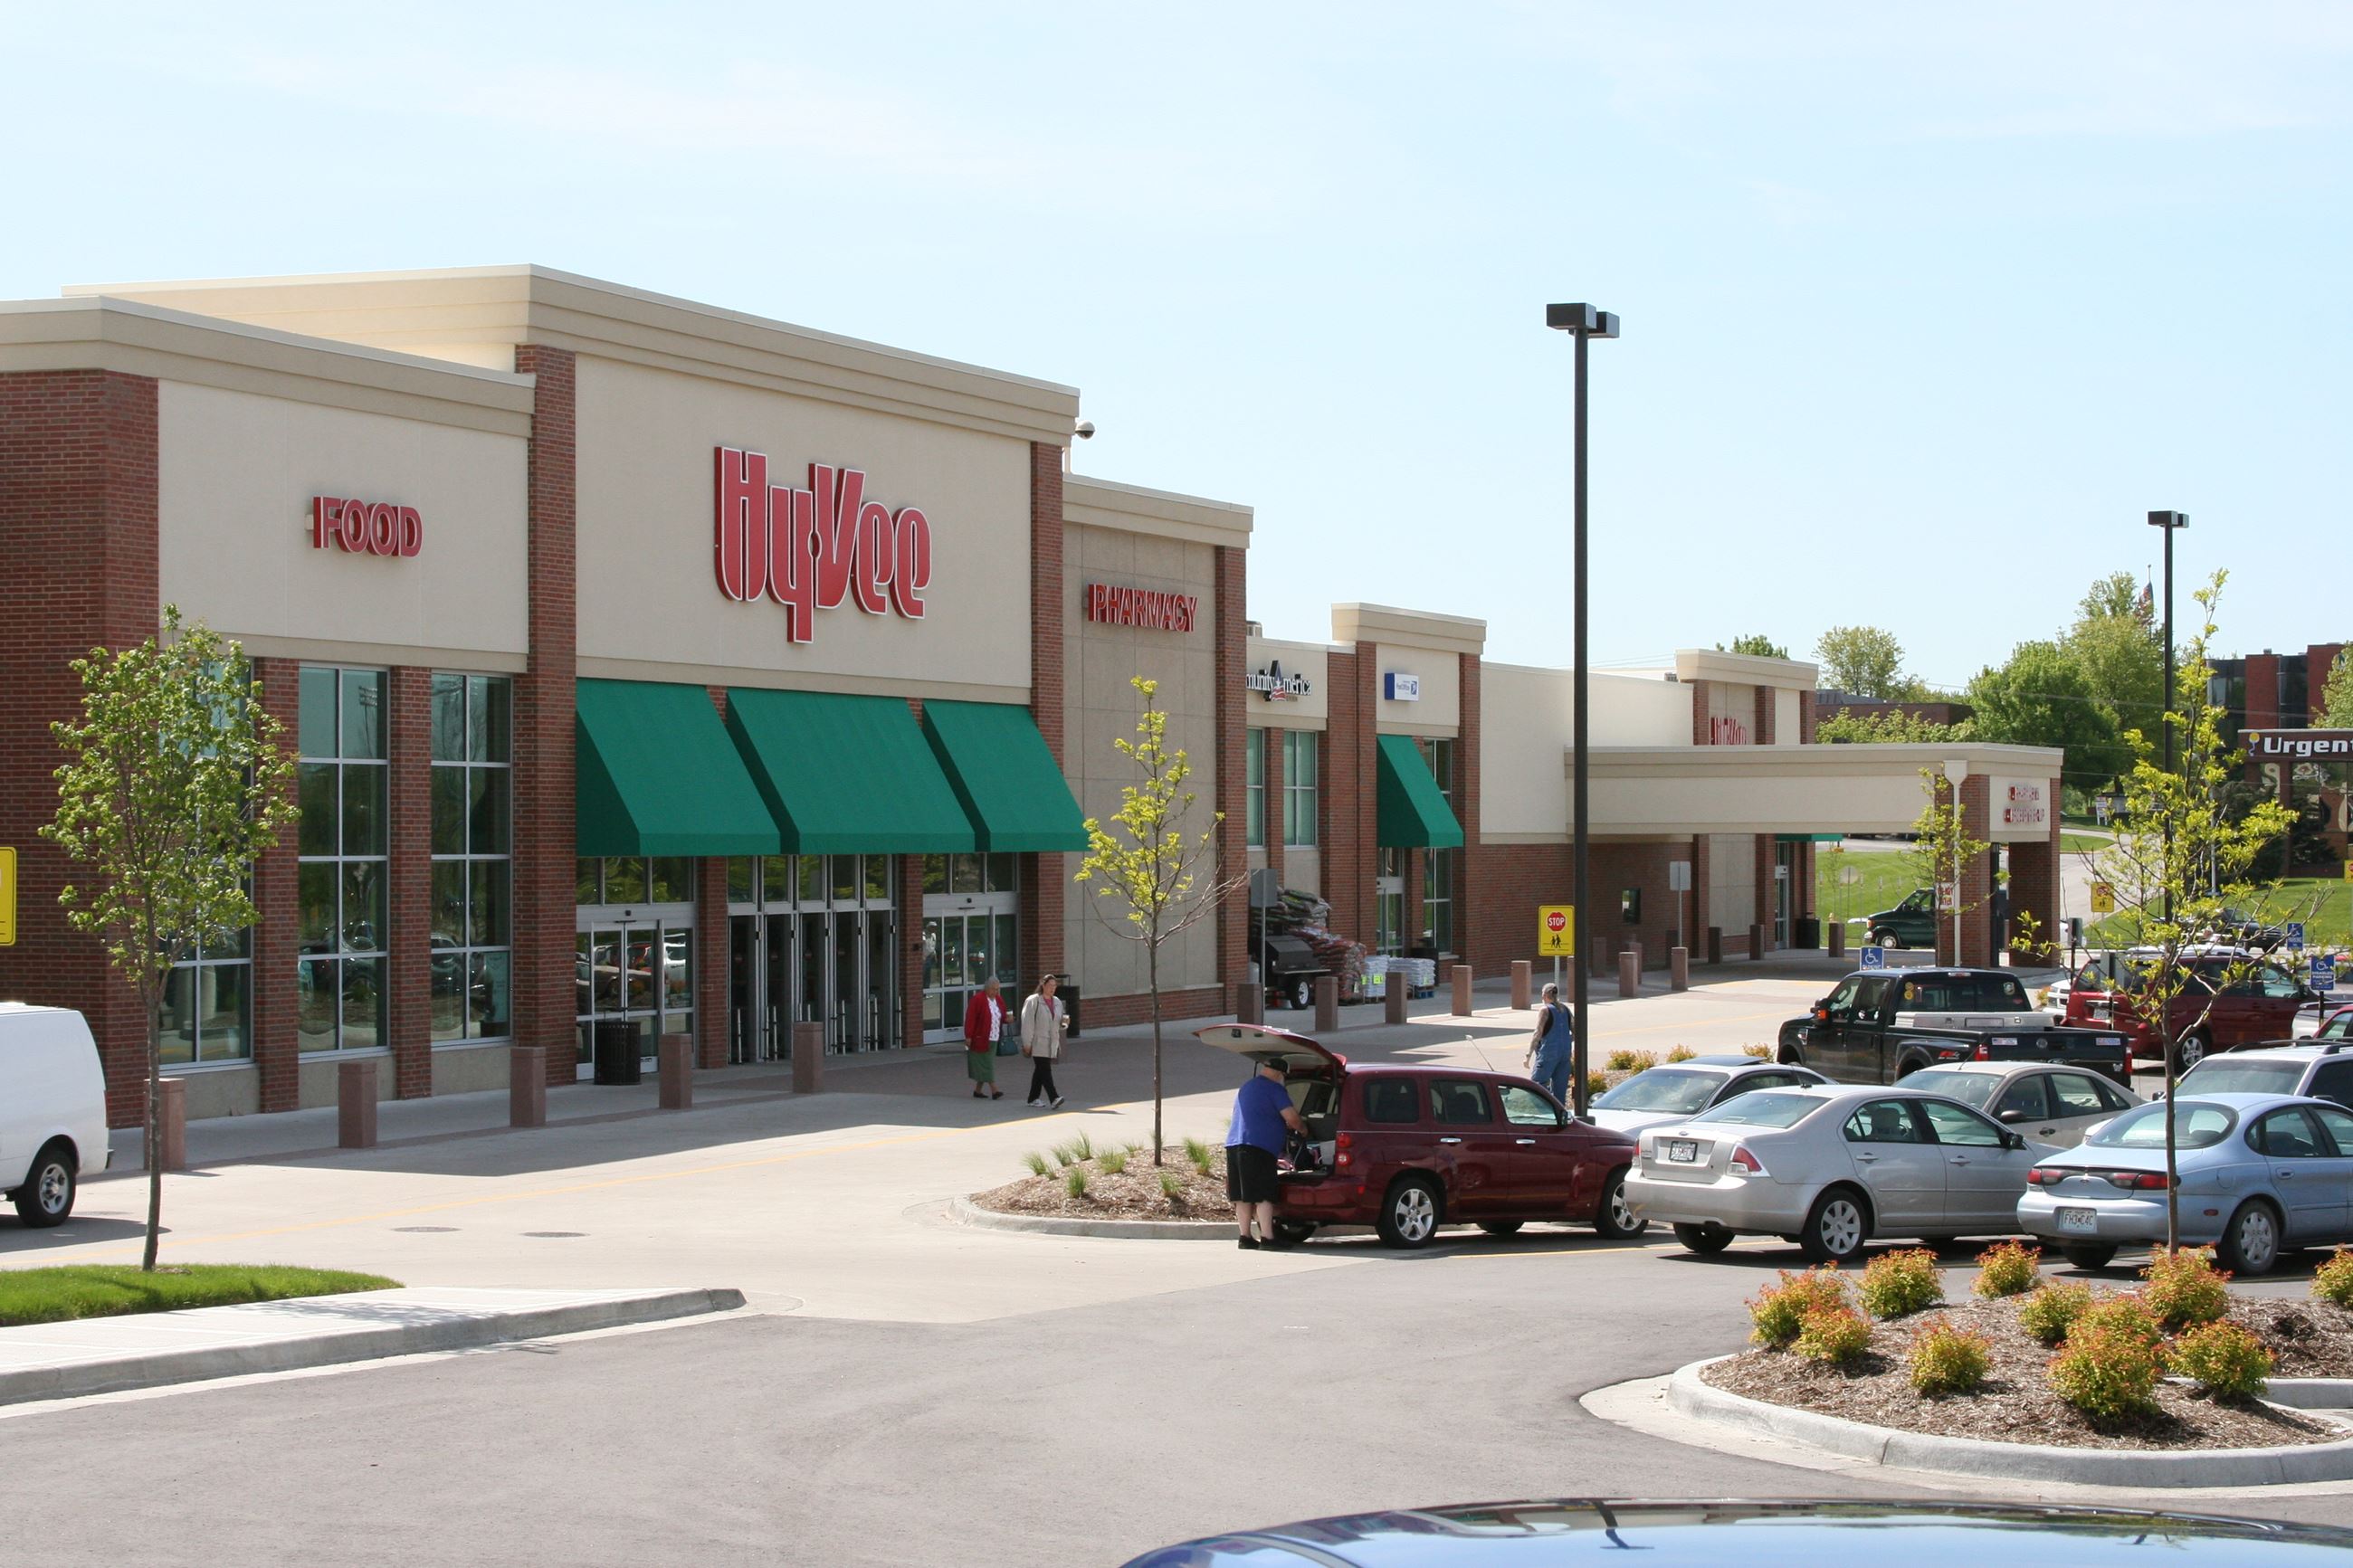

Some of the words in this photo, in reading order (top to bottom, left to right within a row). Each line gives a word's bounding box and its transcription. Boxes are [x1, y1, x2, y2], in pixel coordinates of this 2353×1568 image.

[313, 497, 424, 557] FOOD
[1088, 584, 1198, 632] PHARMACY
[2264, 737, 2353, 757] Urgen
[1548, 917, 1565, 927] STOP
